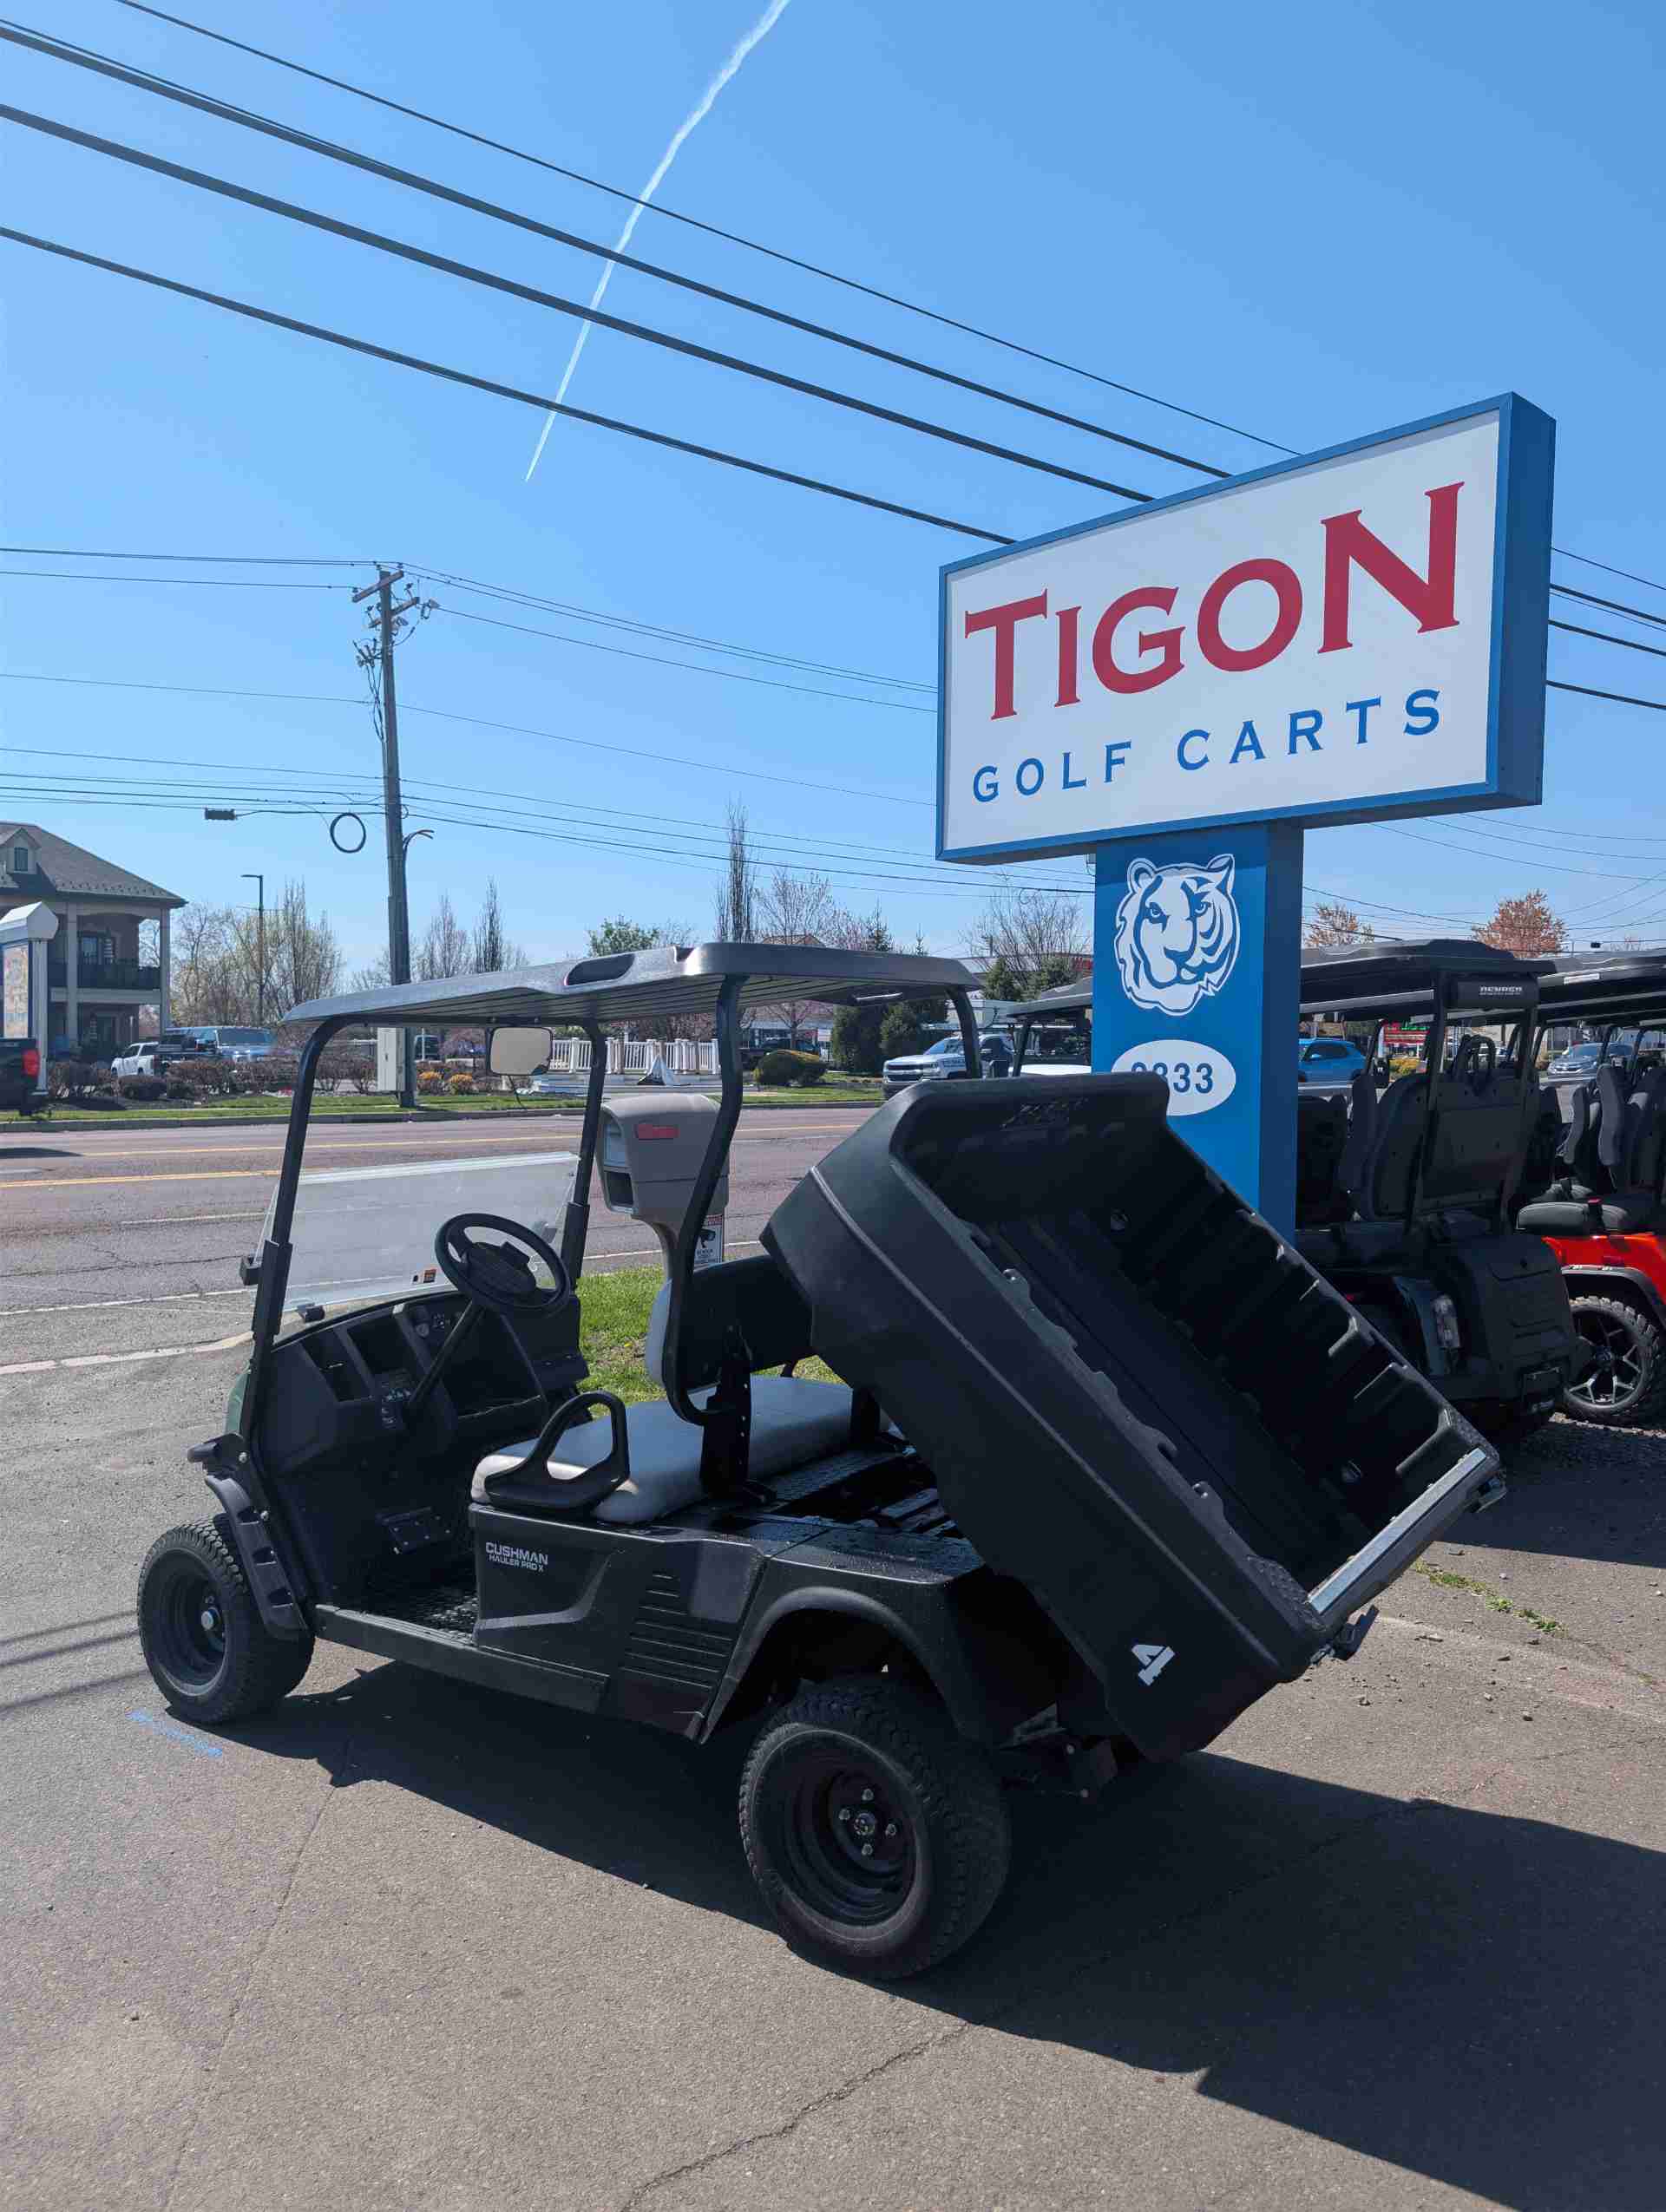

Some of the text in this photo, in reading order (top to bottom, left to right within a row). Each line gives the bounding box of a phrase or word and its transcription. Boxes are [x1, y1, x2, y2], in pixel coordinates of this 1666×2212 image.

[965, 481, 1466, 721] TIGON
[973, 689, 1440, 804] GOLF CARTS
[485, 1541, 548, 1565] CUSHMAN
[489, 1554, 520, 1567] HAULER
[521, 1561, 537, 1571] PRO
